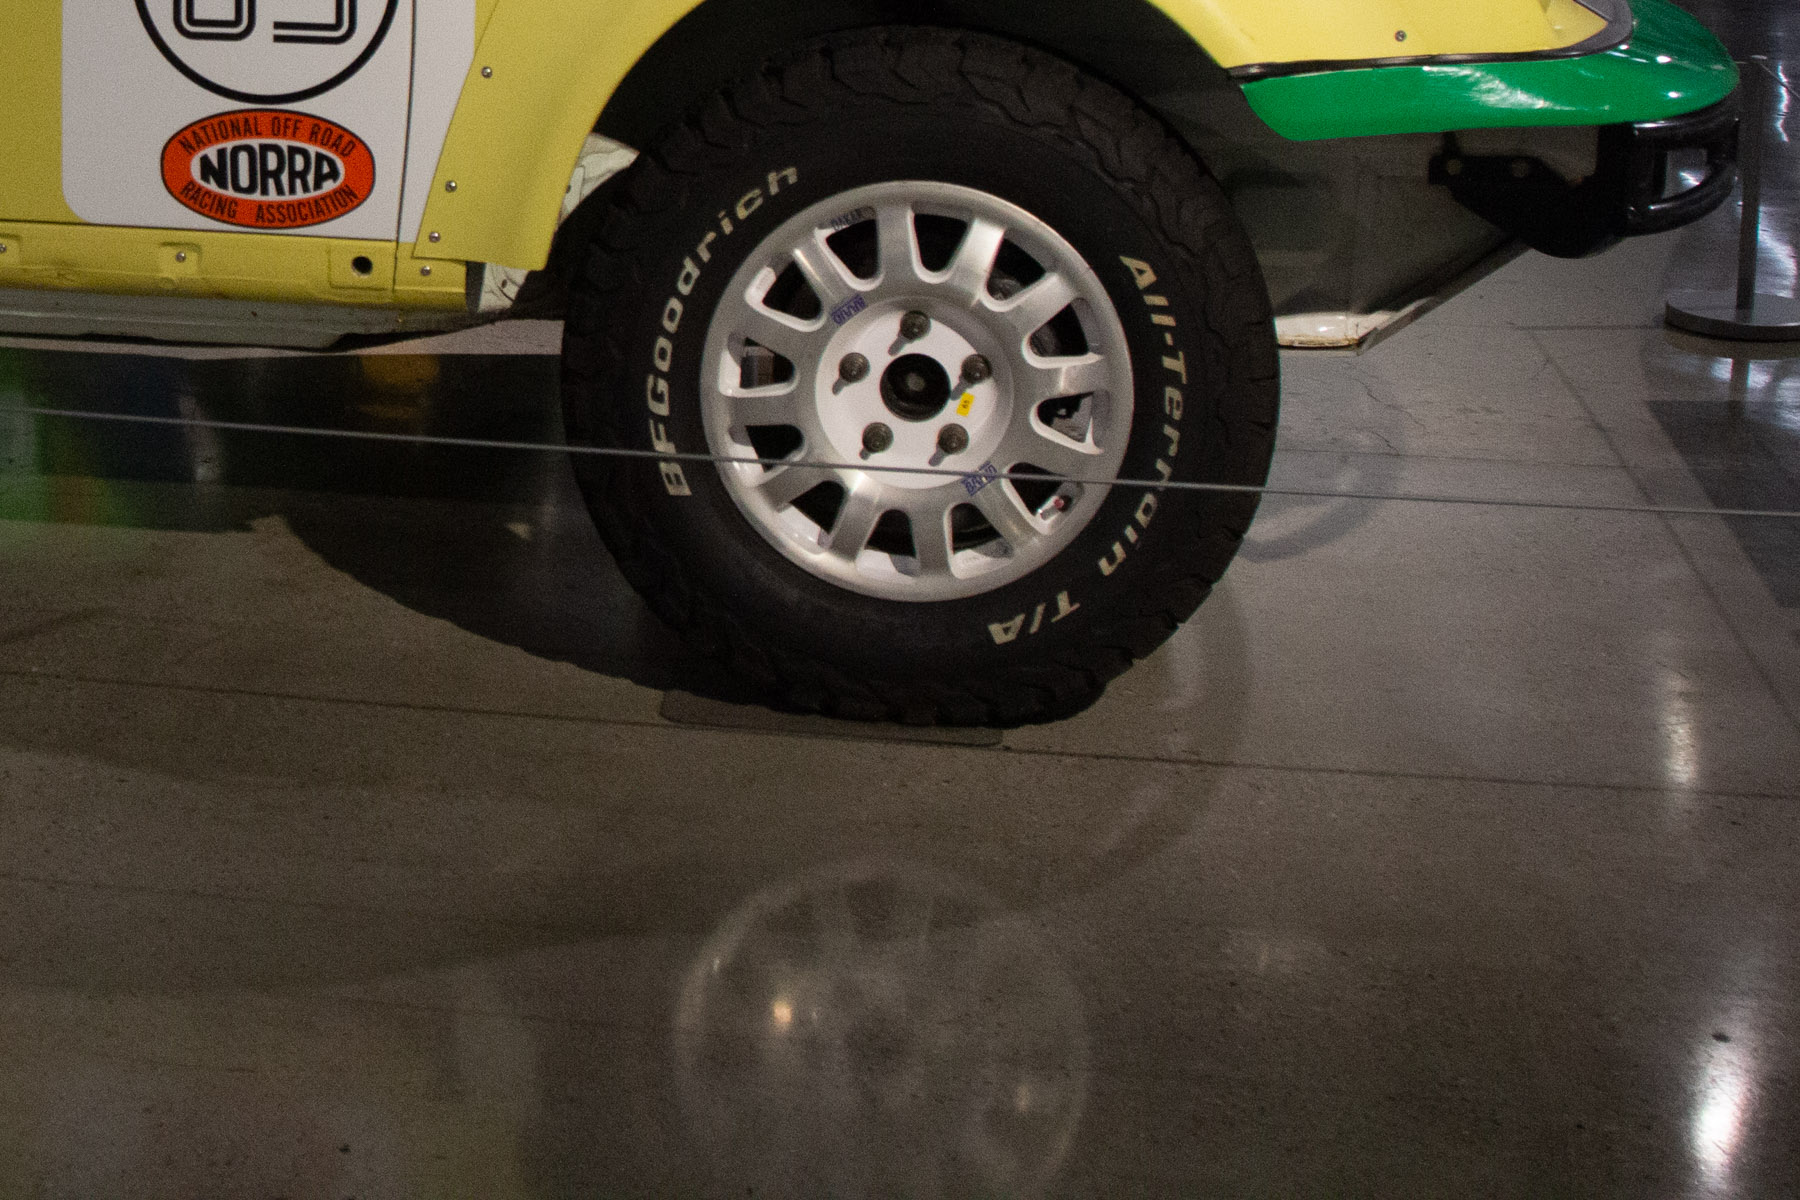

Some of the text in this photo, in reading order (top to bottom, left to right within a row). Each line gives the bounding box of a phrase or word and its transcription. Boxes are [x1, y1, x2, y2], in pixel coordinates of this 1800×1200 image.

[179, 116, 356, 158] NATIONAL OFF ROAD
[200, 143, 341, 197] NORRA
[180, 181, 360, 224] RACING ASSOCIATION
[646, 165, 800, 497] BFGoodrich
[1097, 254, 1188, 577] All-Terrain
